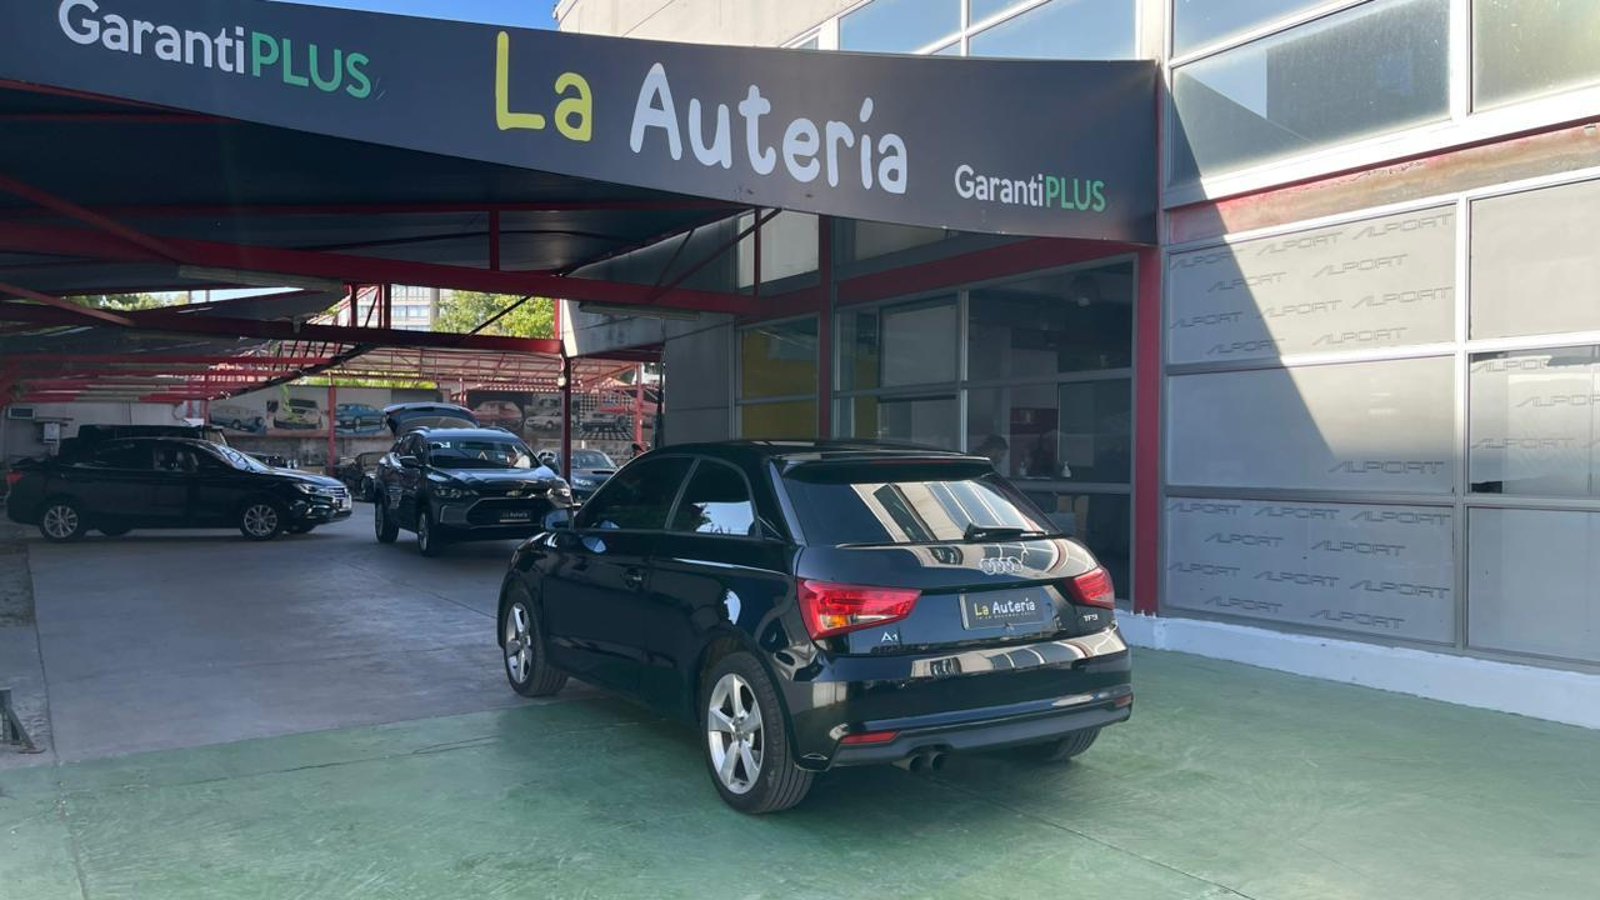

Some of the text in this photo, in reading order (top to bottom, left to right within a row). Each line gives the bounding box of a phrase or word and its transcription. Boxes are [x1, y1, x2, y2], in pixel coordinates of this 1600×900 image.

[58, 0, 372, 99] GarantiPLUS
[495, 31, 908, 194] La Autería
[954, 164, 1106, 213] GarantiPLUS
[1256, 231, 1343, 256] ALPORT
[1353, 213, 1455, 241] ALPORT
[1312, 253, 1408, 278] ALPORT
[1170, 311, 1243, 329] ALPORT
[1351, 286, 1454, 310] ALPORT
[1312, 327, 1407, 346] ALPORT
[1471, 359, 1550, 373] ALPO
[1515, 394, 1600, 408] ALPOR
[1328, 460, 1444, 475] ALPORT
[1254, 506, 1340, 520] ALPORT
[1350, 511, 1451, 526] ALPORT
[1204, 532, 1406, 556] ALPORT ALPORT
[1253, 570, 1340, 588] ALPORT
[1350, 580, 1450, 599] ALPORT
[974, 602, 989, 615] La
[1204, 596, 1405, 629] ALPORT ALPORT
[880, 631, 899, 642] A1
